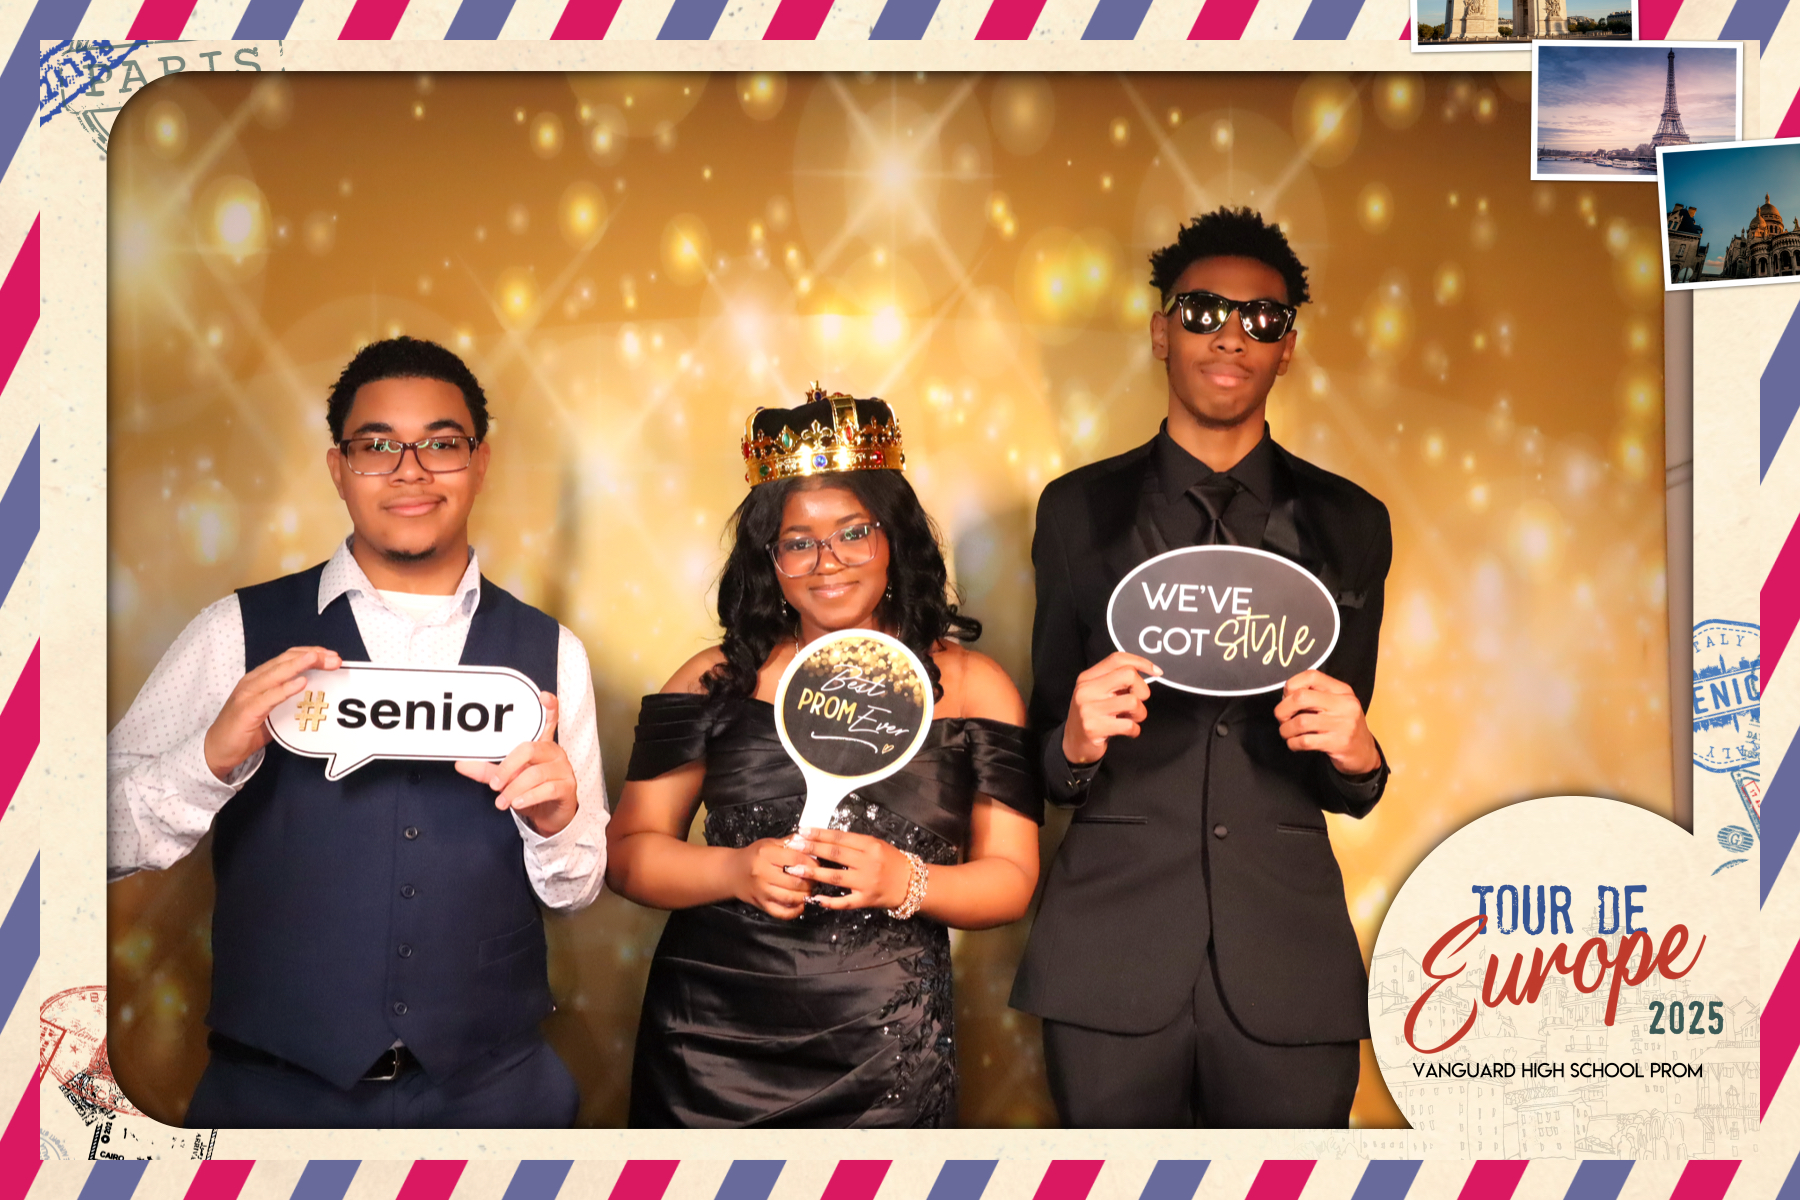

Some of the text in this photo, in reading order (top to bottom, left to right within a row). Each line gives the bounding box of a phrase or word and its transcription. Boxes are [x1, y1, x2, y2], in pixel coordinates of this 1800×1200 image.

[1141, 582, 1253, 615] WE'VE
[1138, 625, 1211, 656] GOT
[821, 664, 885, 697] Best
[294, 690, 514, 733] #senior
[797, 687, 909, 736] PROM Ever
